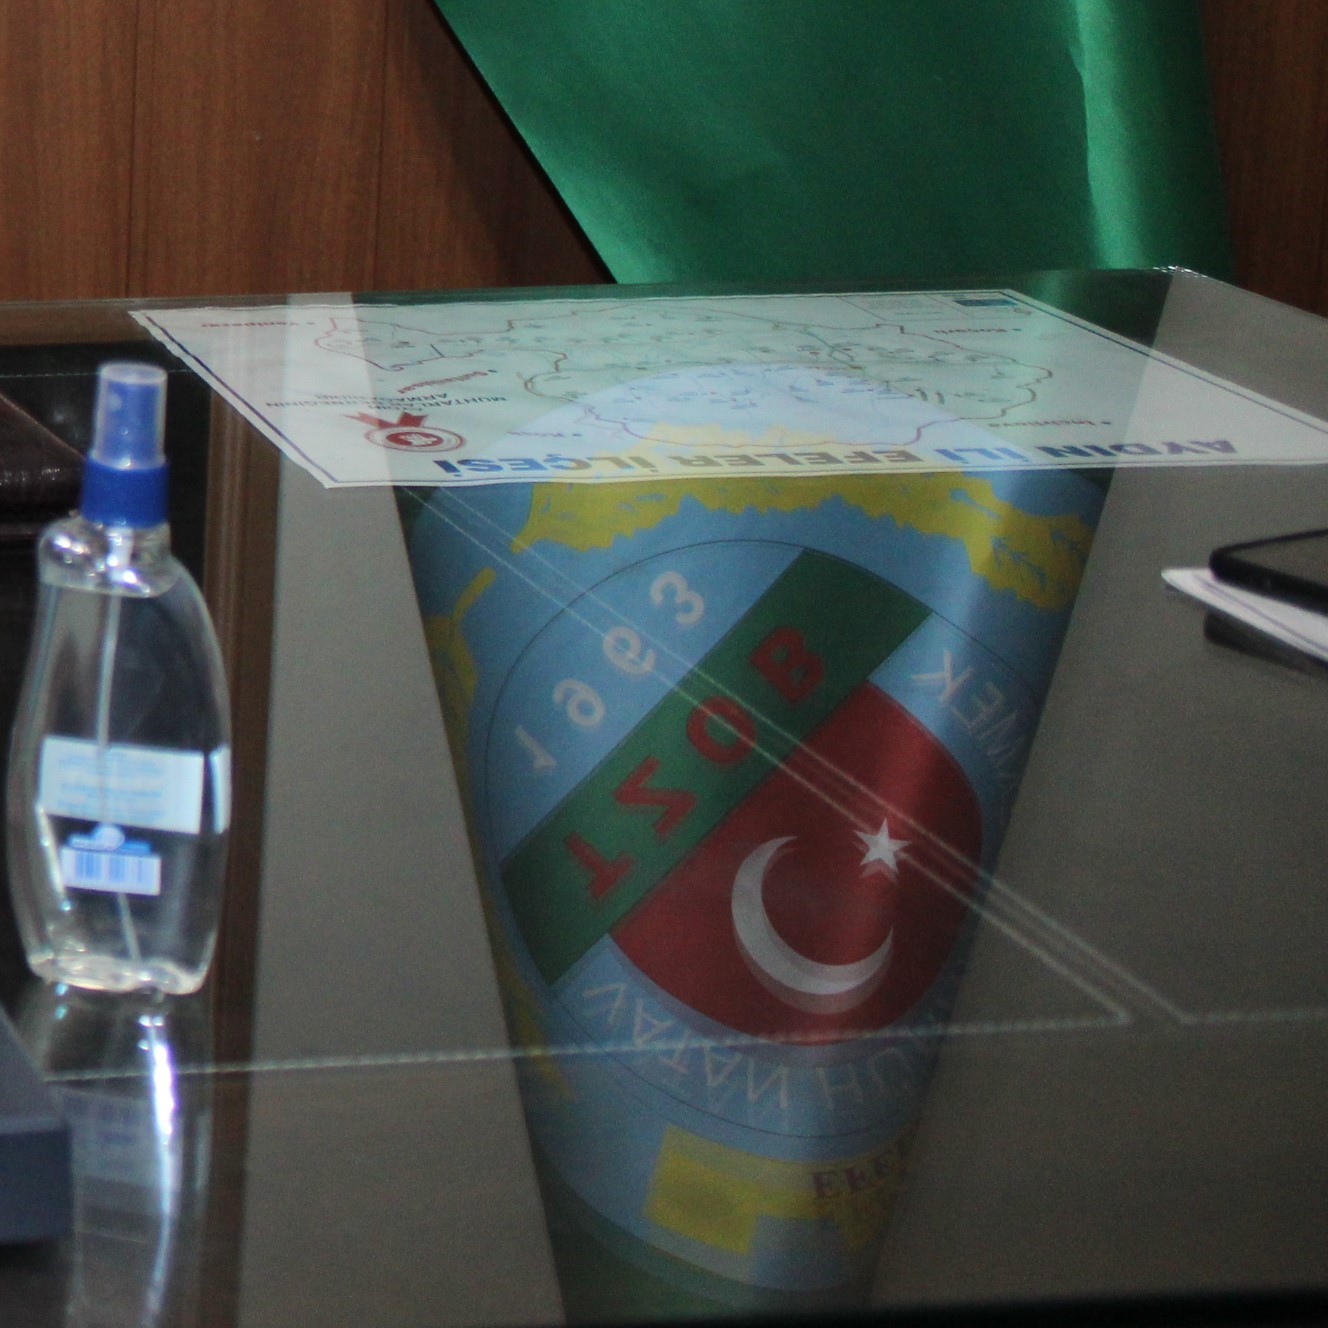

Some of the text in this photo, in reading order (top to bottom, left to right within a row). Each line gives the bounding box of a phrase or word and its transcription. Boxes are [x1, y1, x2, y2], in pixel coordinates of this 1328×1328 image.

[433, 439, 1238, 478] AYDIN İLİ EFELER İLÇESİ
